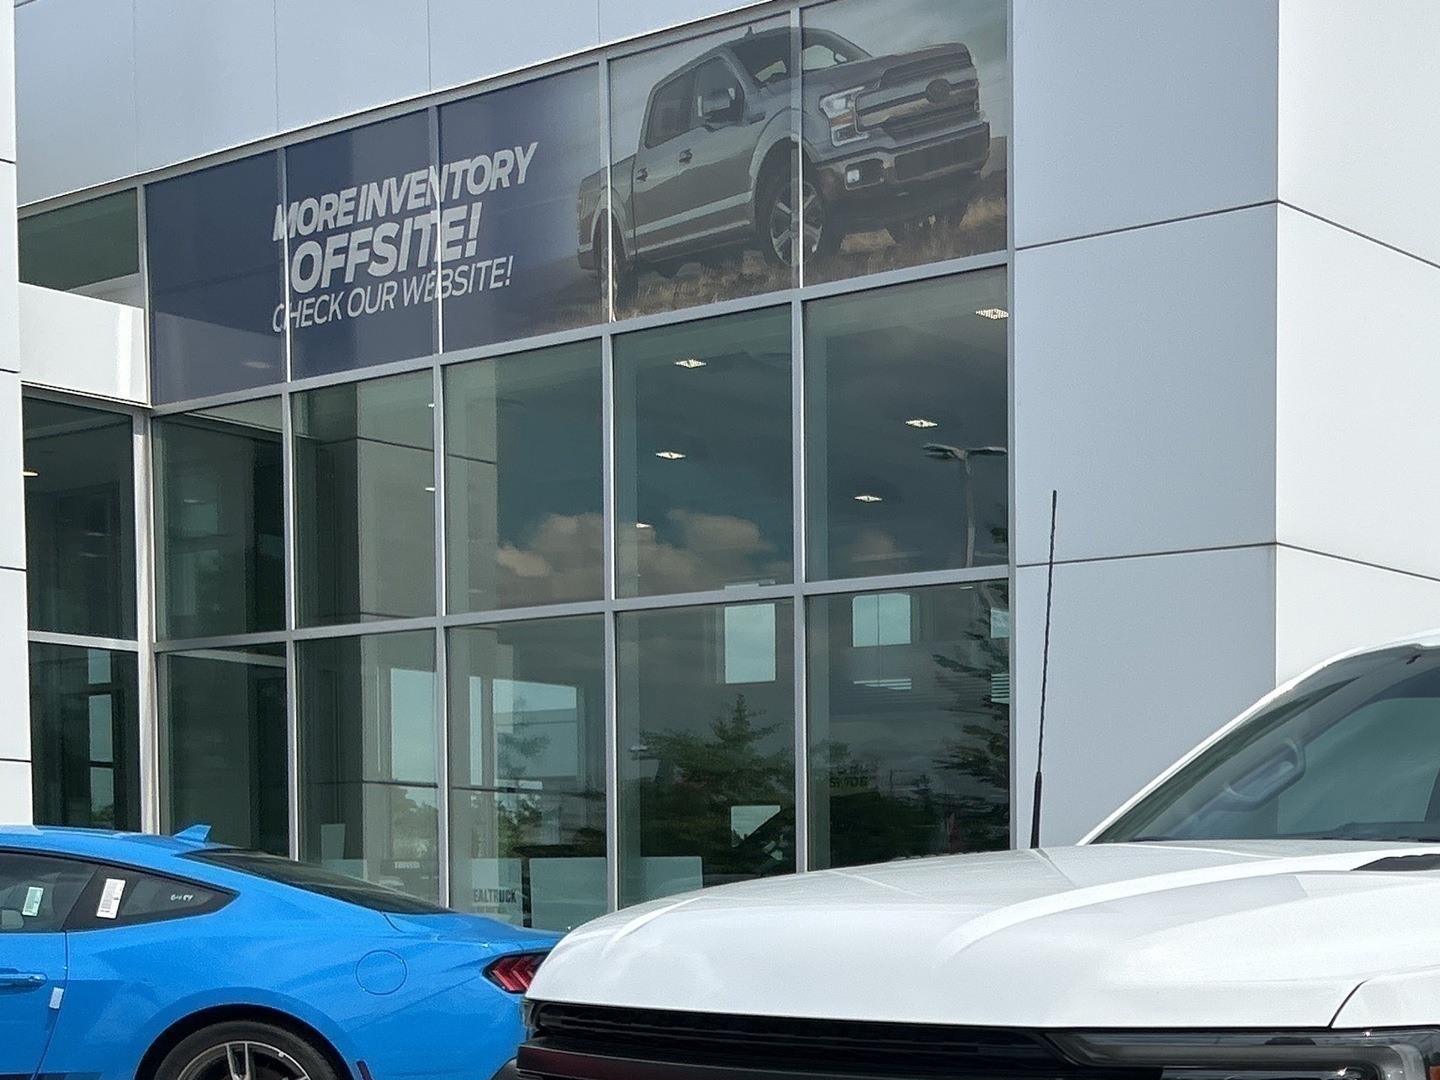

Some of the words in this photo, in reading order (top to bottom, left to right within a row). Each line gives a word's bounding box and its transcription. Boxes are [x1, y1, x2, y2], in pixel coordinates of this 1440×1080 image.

[272, 187, 357, 241] MORE
[357, 141, 538, 222] INVENTORY
[291, 202, 483, 293] OFFSITE!
[272, 291, 346, 333] CHECK
[348, 280, 399, 318] OUR
[402, 255, 514, 307] WEBSITE!
